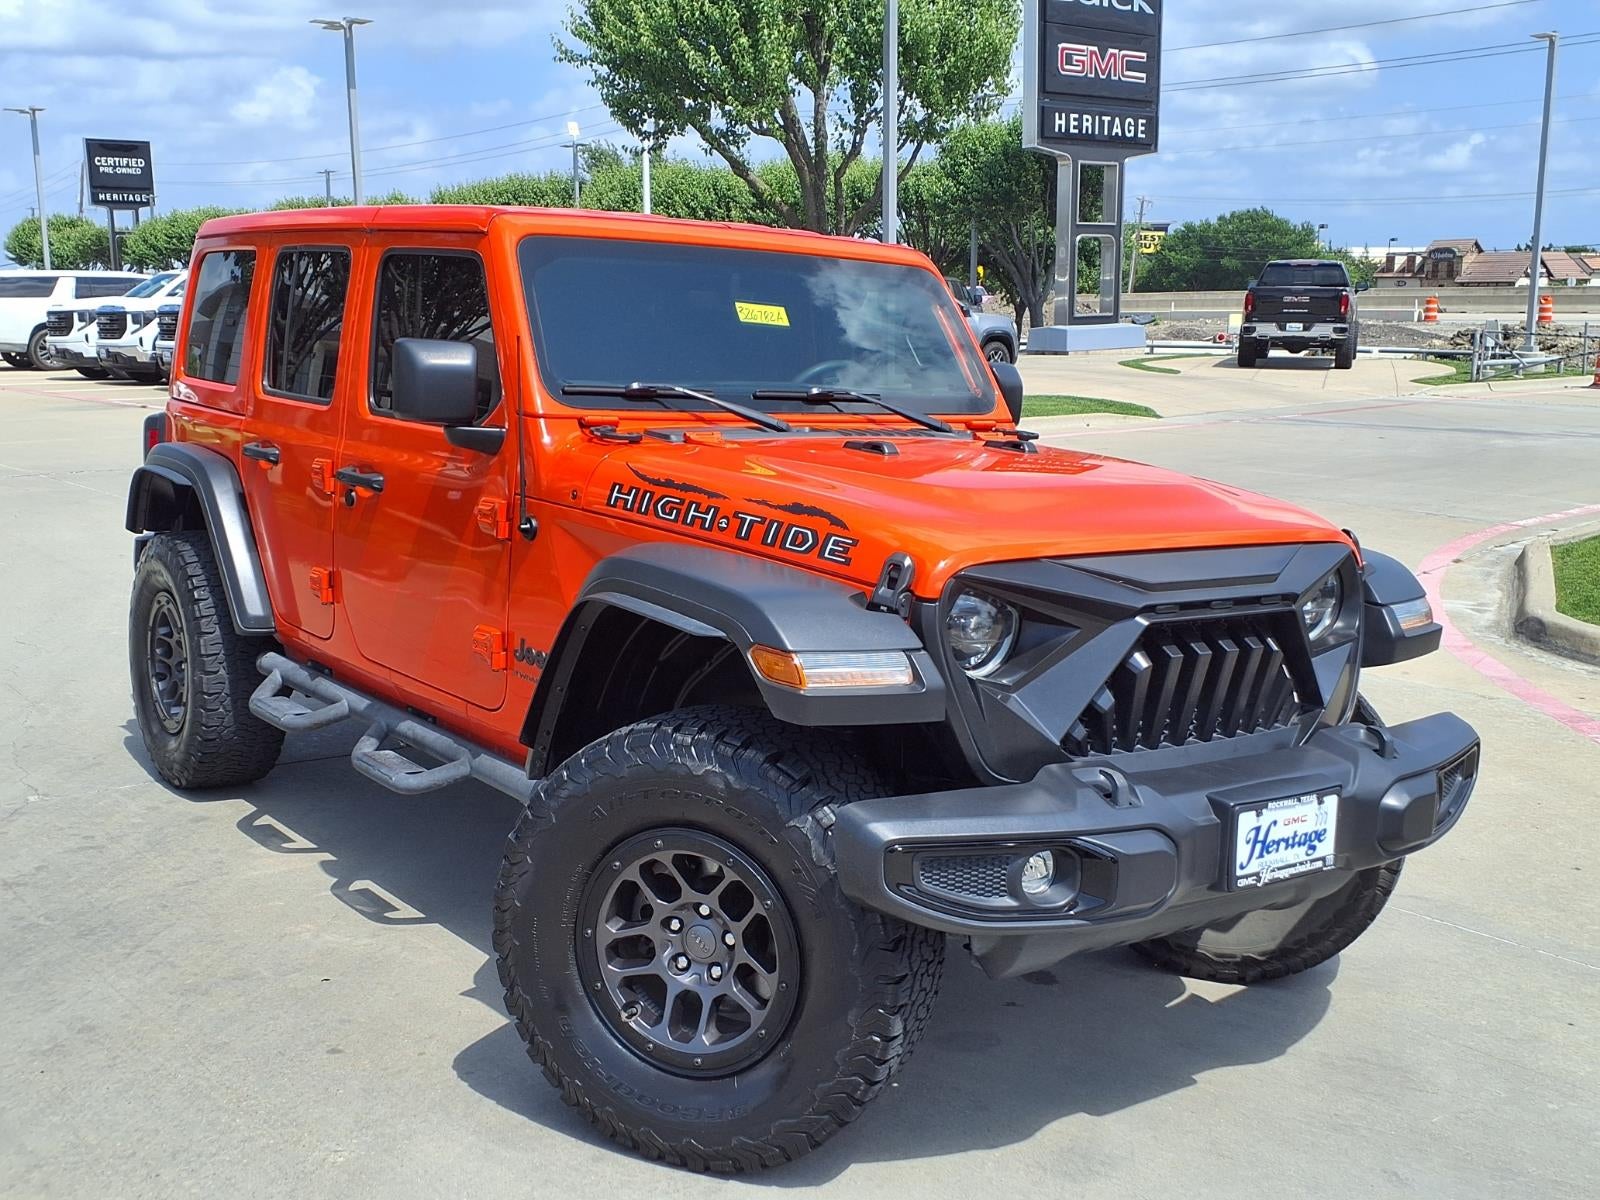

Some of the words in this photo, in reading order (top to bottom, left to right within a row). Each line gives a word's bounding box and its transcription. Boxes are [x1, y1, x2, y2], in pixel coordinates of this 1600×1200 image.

[1058, 43, 1147, 83] GMC
[1054, 112, 1146, 138] HERITAGE
[94, 156, 145, 167] CERTIFIED
[99, 166, 142, 175] PRE-OWNED
[98, 193, 148, 202] HERITAGE
[1138, 234, 1162, 242] EST
[606, 481, 720, 532] HIGH
[733, 511, 859, 566] TIDE
[514, 637, 548, 669] Jee
[1283, 814, 1308, 826] GMC
[1238, 819, 1328, 871] Heritage
